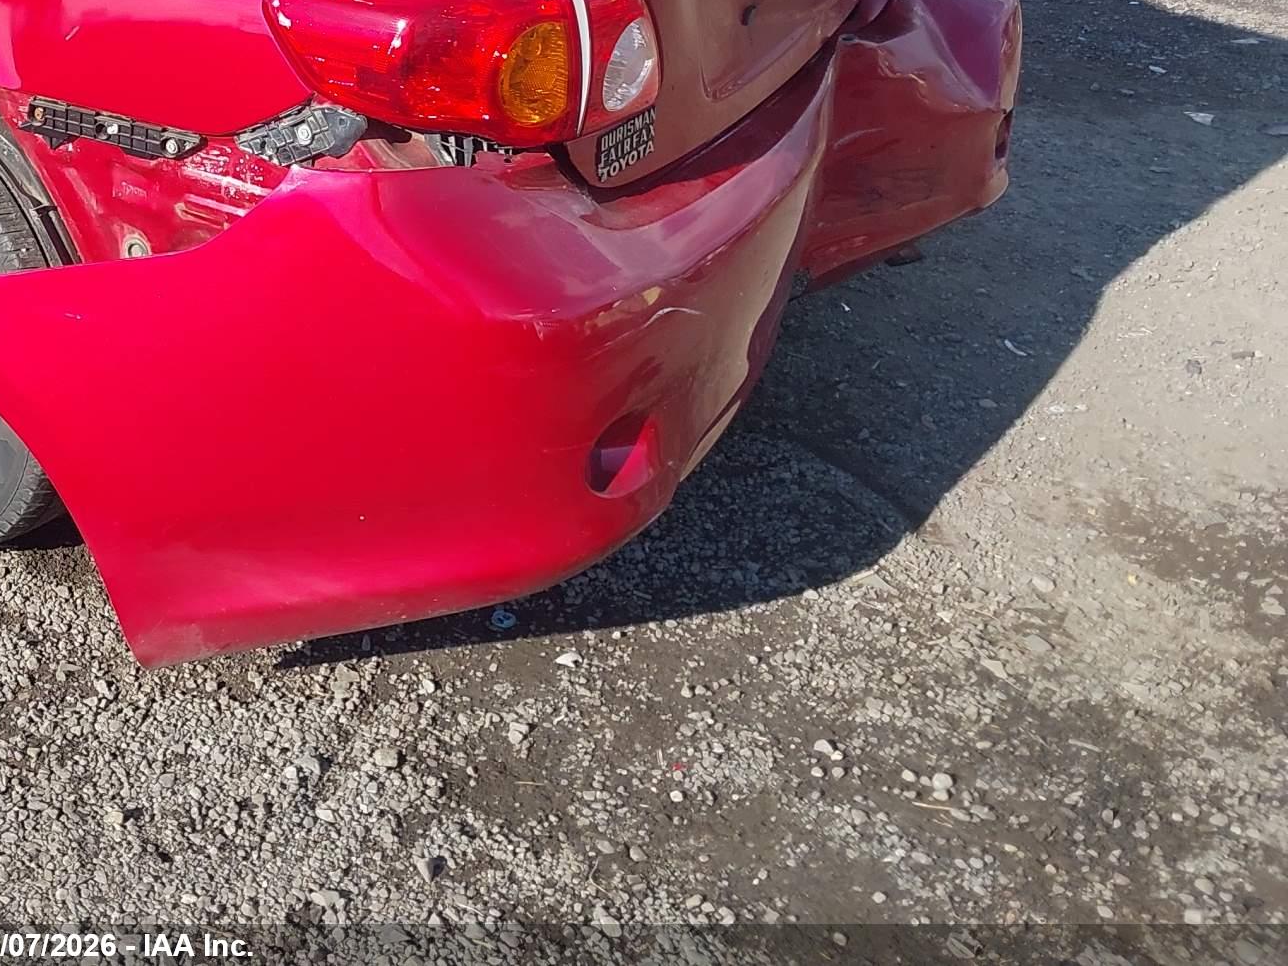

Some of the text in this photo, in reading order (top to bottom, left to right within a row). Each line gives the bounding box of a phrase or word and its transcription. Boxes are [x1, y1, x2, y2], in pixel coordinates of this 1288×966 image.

[600, 124, 655, 168] FAIRFAX
[601, 107, 657, 151] OURISMAN
[598, 140, 655, 183] TOYOTA
